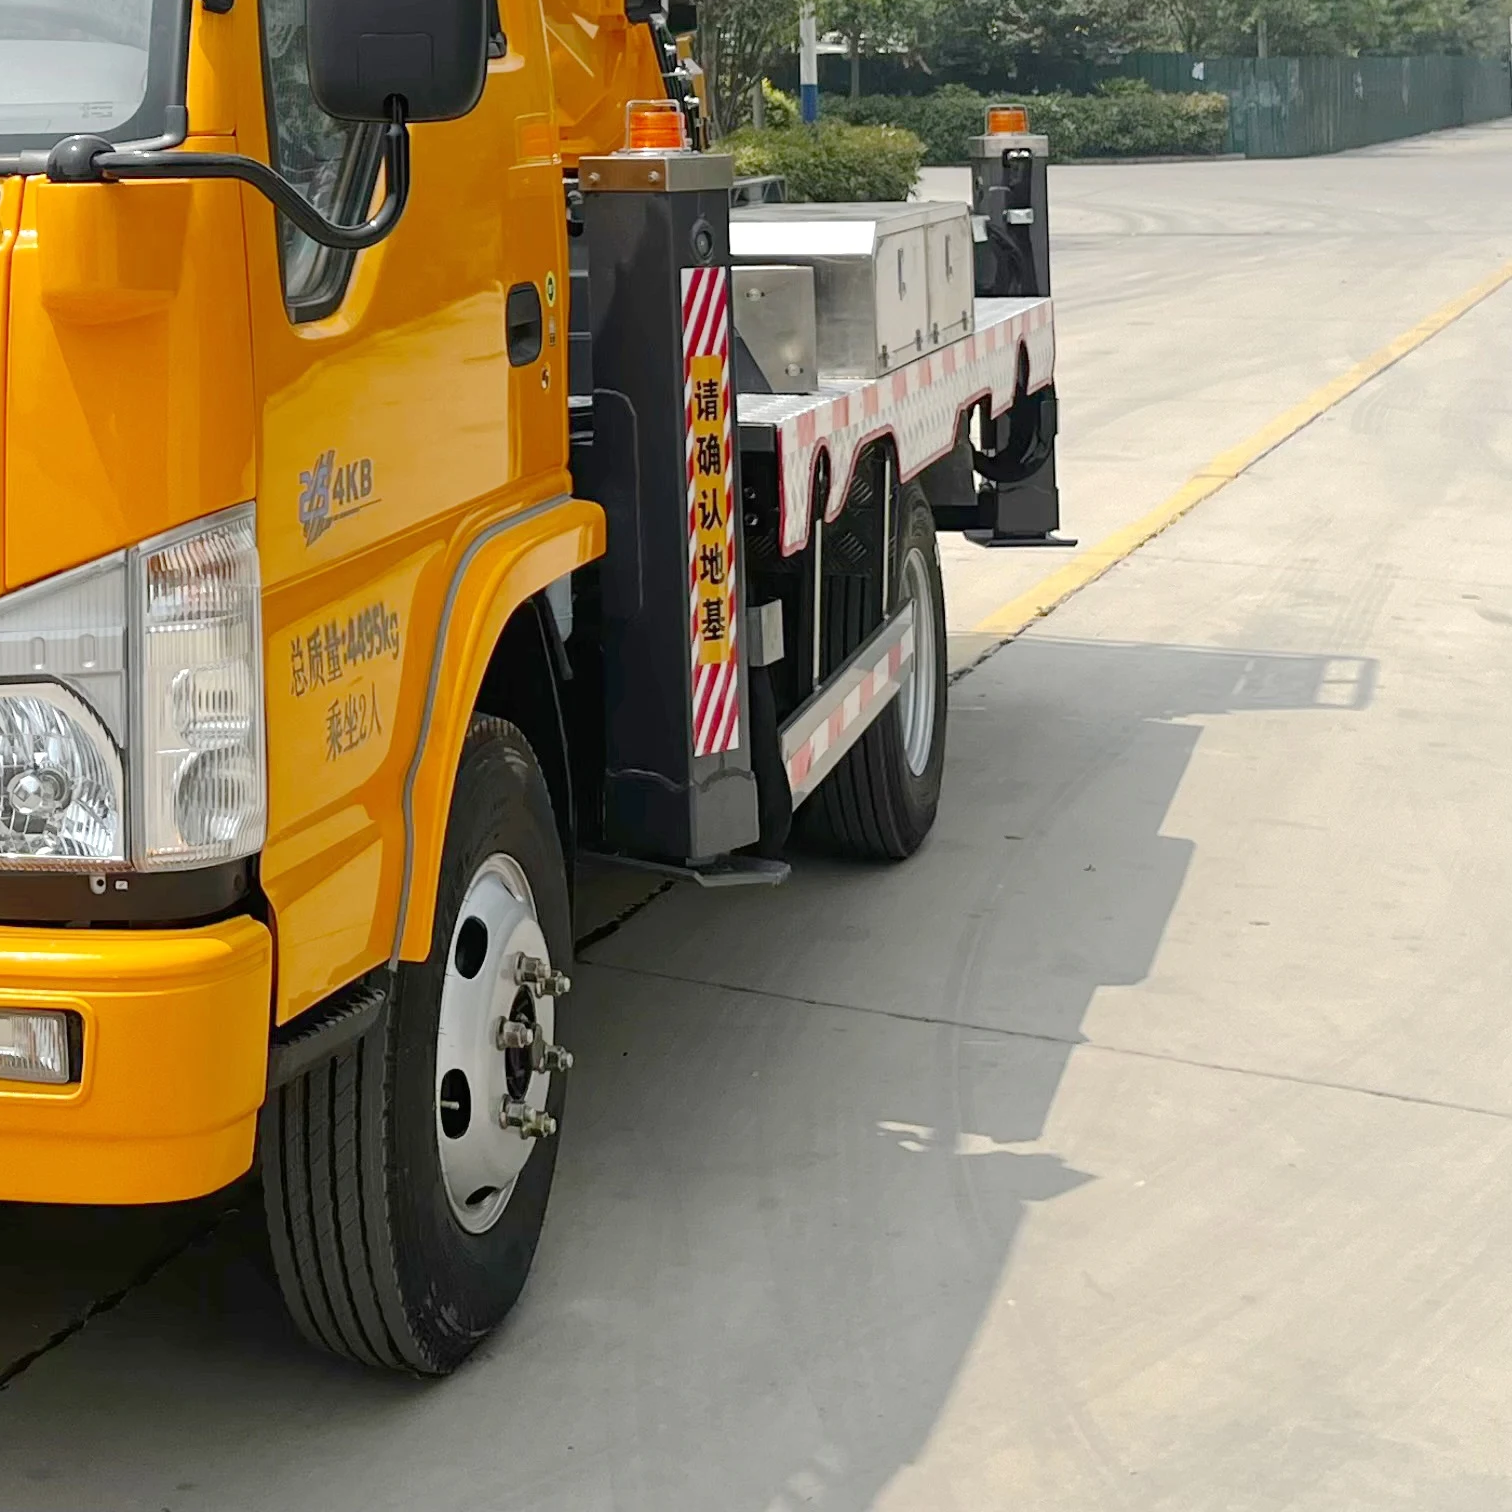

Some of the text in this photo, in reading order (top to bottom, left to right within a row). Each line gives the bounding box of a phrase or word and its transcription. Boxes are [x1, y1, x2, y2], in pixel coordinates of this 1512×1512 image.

[332, 458, 373, 506] 4KB
[694, 377, 726, 641] 请确认地基
[325, 681, 383, 763] 乘坐2人
